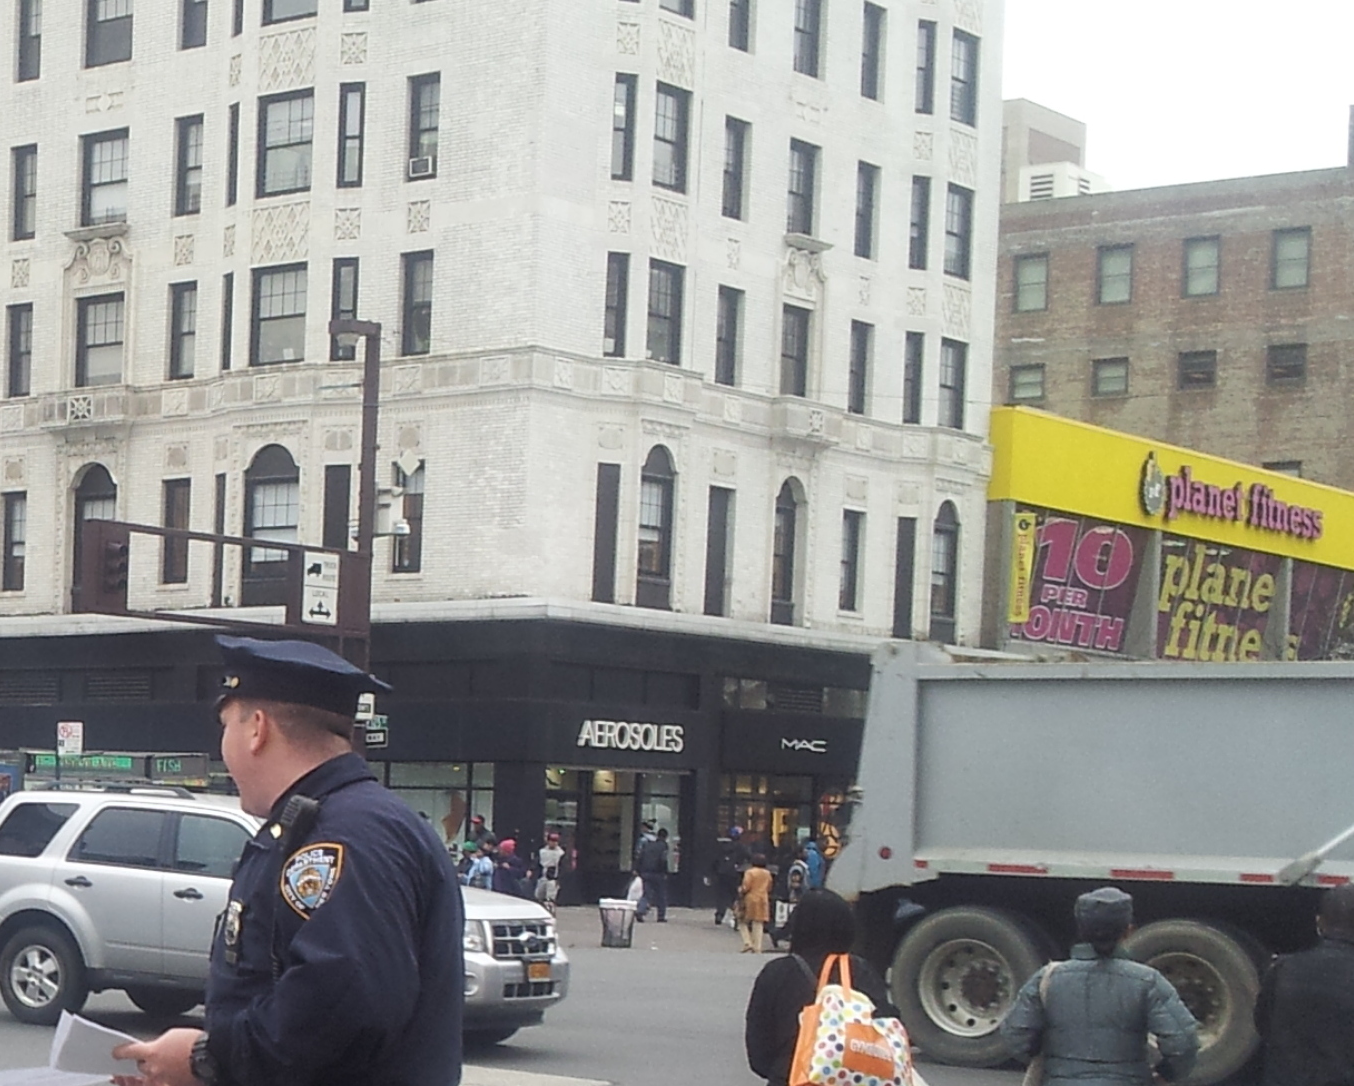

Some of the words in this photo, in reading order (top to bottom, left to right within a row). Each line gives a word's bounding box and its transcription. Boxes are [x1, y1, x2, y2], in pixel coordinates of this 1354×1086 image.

[1165, 465, 1243, 520] planet
[1248, 482, 1324, 540] fitness
[1041, 583, 1088, 609] PER
[1158, 545, 1275, 612] plane
[1164, 601, 1264, 662] fitne
[577, 719, 684, 752] AEROSOLES
[780, 737, 827, 752] MAC
